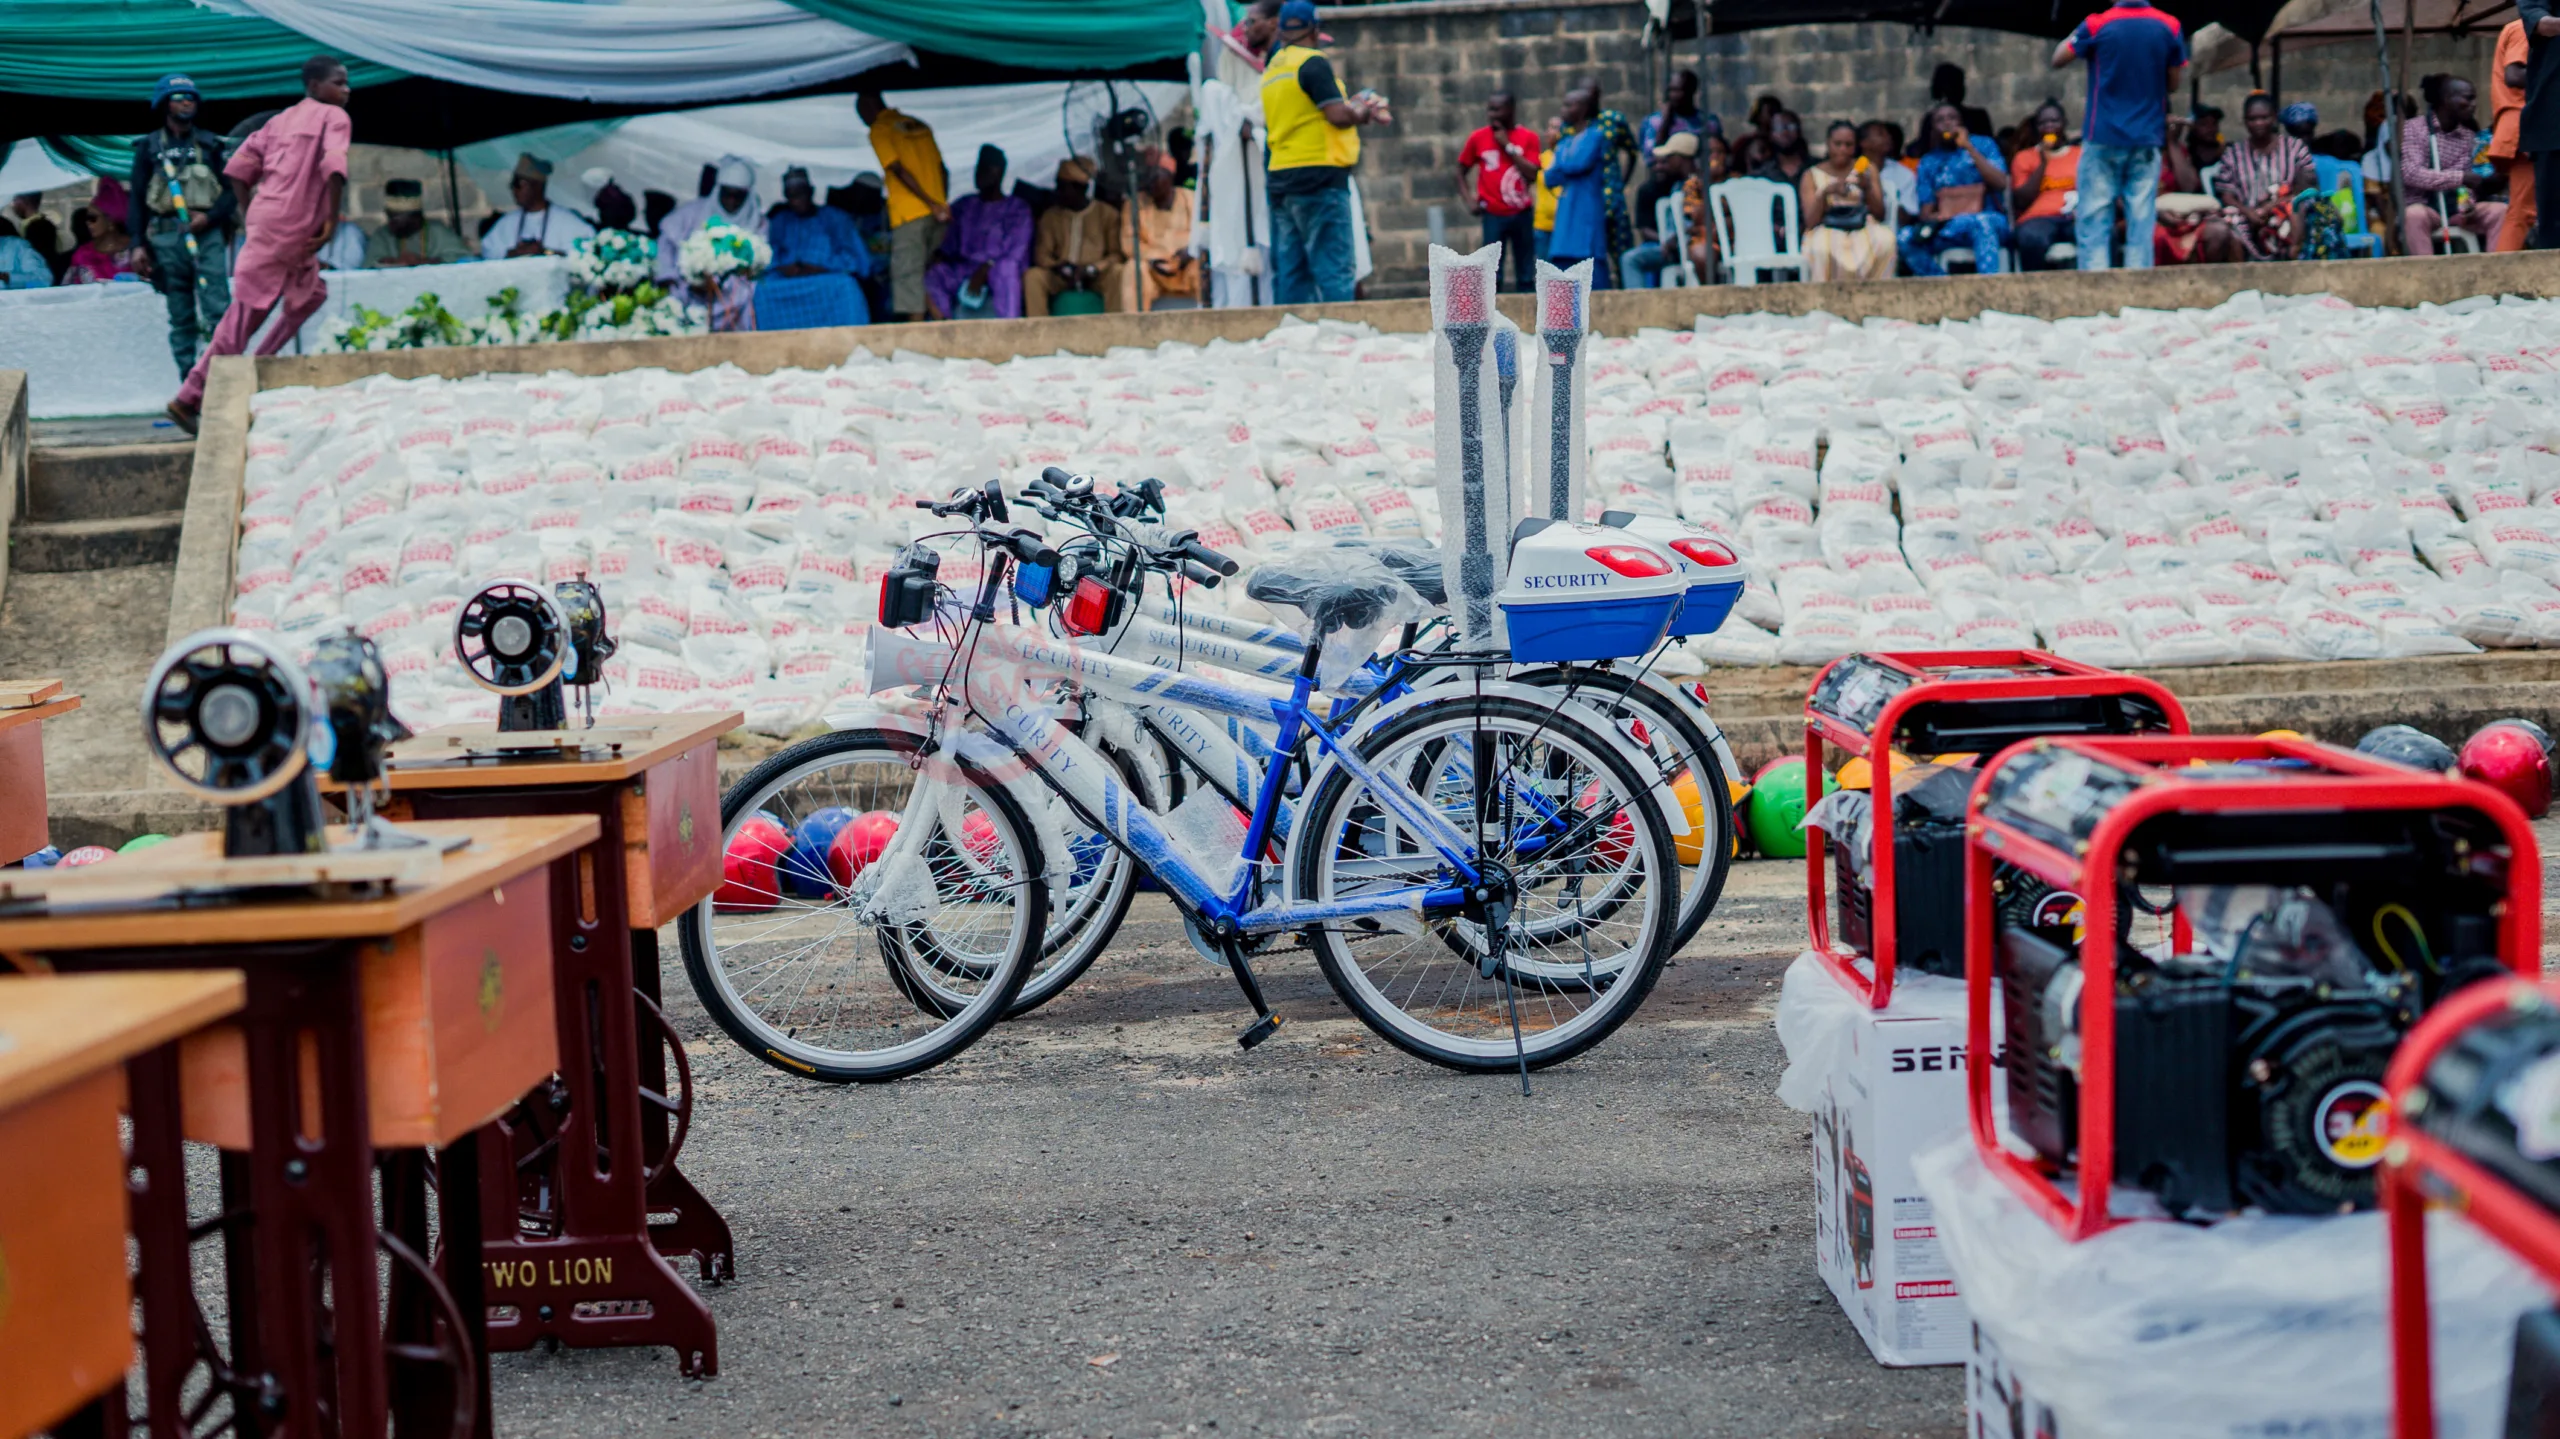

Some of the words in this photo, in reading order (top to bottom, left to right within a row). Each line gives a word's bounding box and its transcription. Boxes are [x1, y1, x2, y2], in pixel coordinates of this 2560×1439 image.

[1524, 572, 1611, 589] SECURITY
[1163, 607, 1232, 634] POLICE
[1011, 639, 1117, 679] SECURITY
[1148, 629, 1245, 663] SECURITY
[1006, 703, 1078, 773] CURITY
[1157, 705, 1212, 755] URITY
[70, 848, 105, 865] OGD
[548, 1257, 612, 1287] LION
